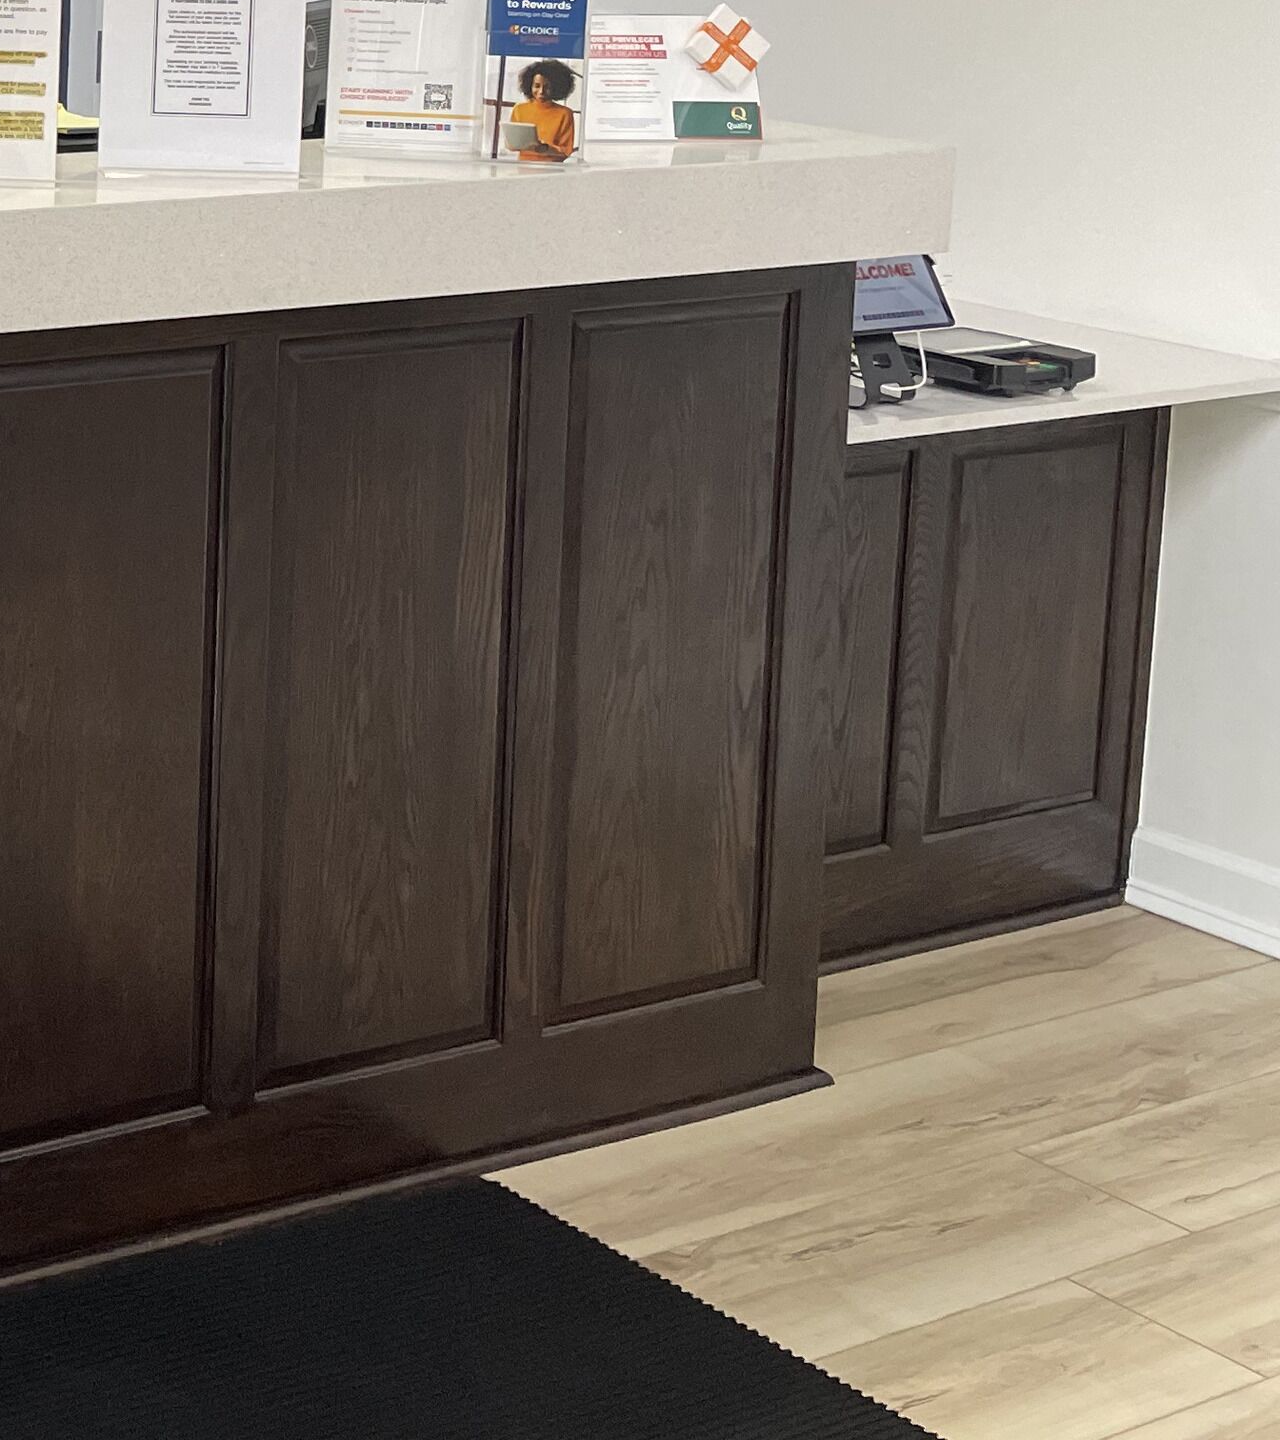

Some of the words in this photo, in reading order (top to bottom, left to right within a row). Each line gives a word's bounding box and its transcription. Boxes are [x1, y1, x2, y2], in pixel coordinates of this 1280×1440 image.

[507, 0, 519, 8] to
[521, 0, 572, 10] Rewards
[520, 25, 560, 35] CHOICE
[726, 121, 753, 131] Quality
[855, 263, 915, 280] ELCOME!
